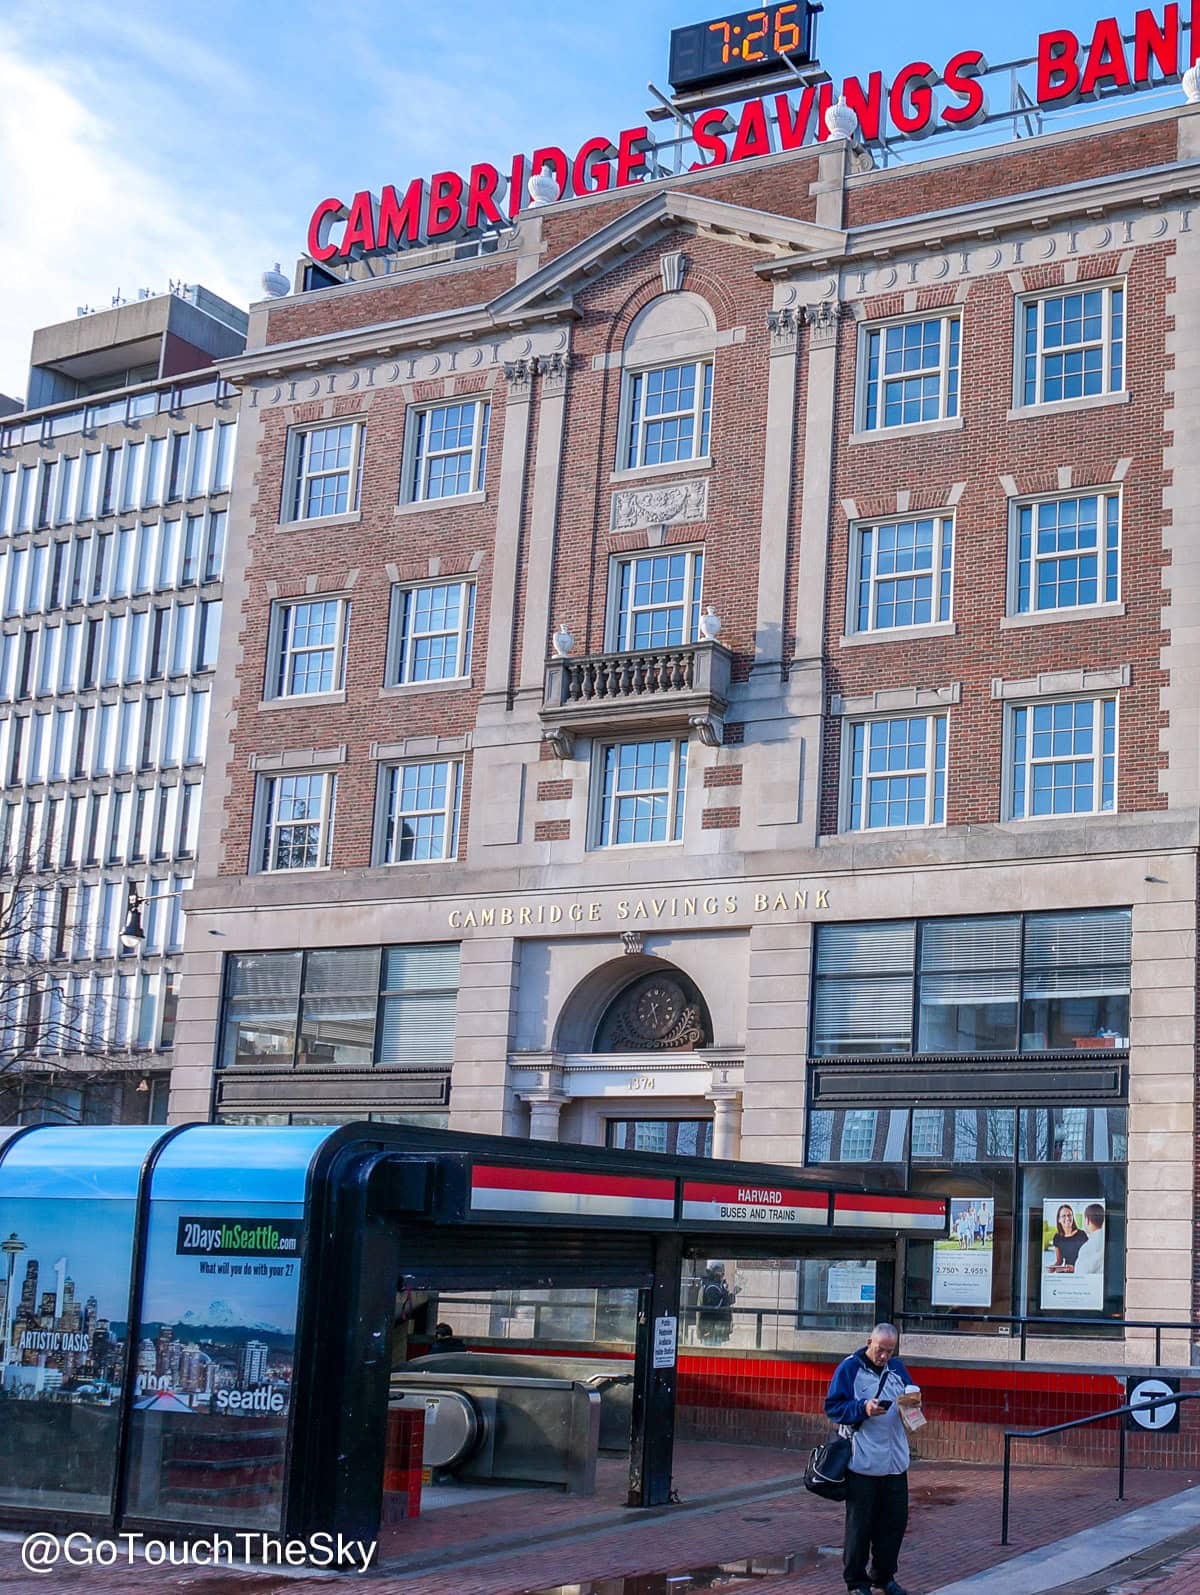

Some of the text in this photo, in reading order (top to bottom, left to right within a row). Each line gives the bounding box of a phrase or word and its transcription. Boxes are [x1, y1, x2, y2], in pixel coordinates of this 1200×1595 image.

[708, 3, 800, 64] 7:26
[307, 126, 652, 266] CAMBRIDGE
[688, 50, 985, 171] SAVINGS
[448, 889, 832, 928] CAMBRIDGE SAVINGS BANK
[737, 1189, 782, 1204] HARVARD
[720, 1206, 796, 1221] BUSES AND TRAINS
[183, 1223, 297, 1252] 2DaysInSeattle.com
[200, 1262, 216, 1274] What
[218, 1262, 230, 1274] will
[231, 1265, 242, 1277] you
[244, 1263, 252, 1275] do
[253, 1263, 267, 1276] with
[269, 1266, 284, 1278] your
[20, 1331, 89, 1352] ARTISTIC OASIS
[216, 1385, 284, 1411] seattle
[1140, 1391, 1167, 1423] T
